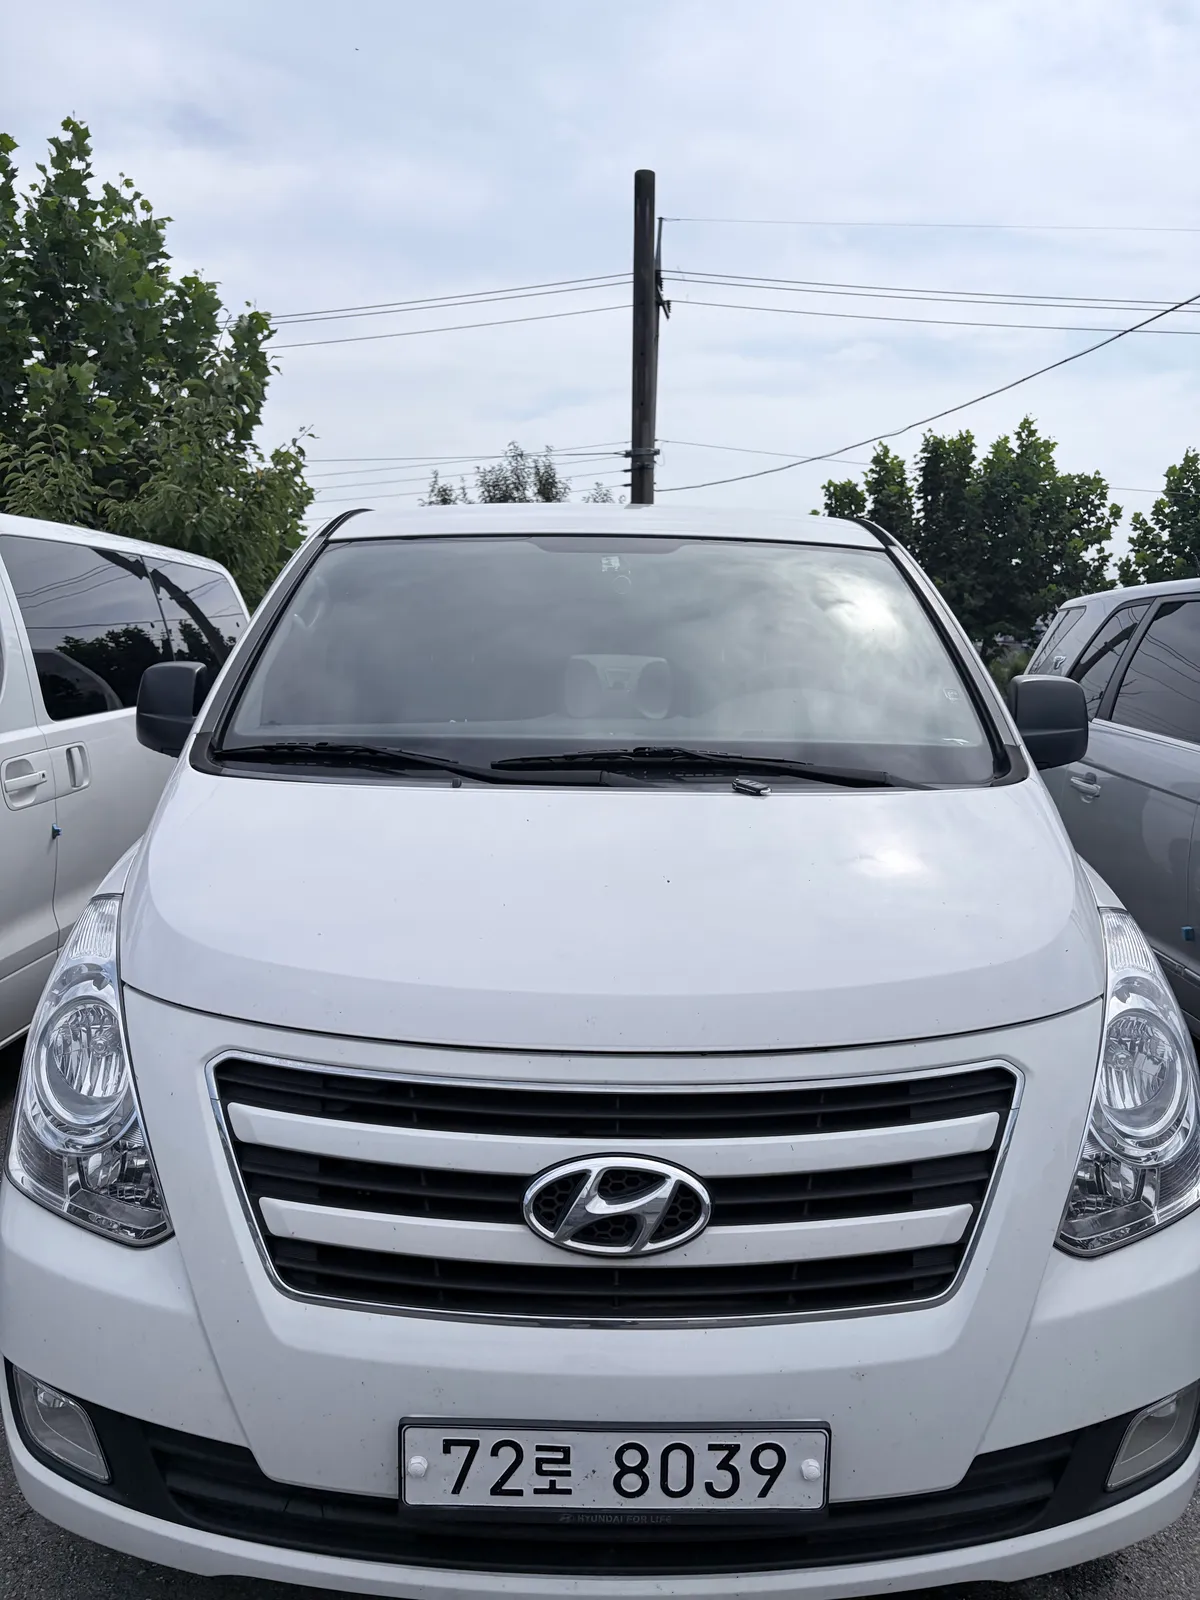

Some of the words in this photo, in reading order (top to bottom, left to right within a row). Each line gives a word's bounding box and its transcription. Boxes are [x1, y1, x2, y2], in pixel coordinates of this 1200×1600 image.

[442, 1438, 573, 1497] 72로
[613, 1441, 787, 1499] 8039
[577, 1514, 623, 1524] HYUNDAI
[626, 1515, 647, 1524] FOR
[651, 1515, 672, 1524] LIFE
